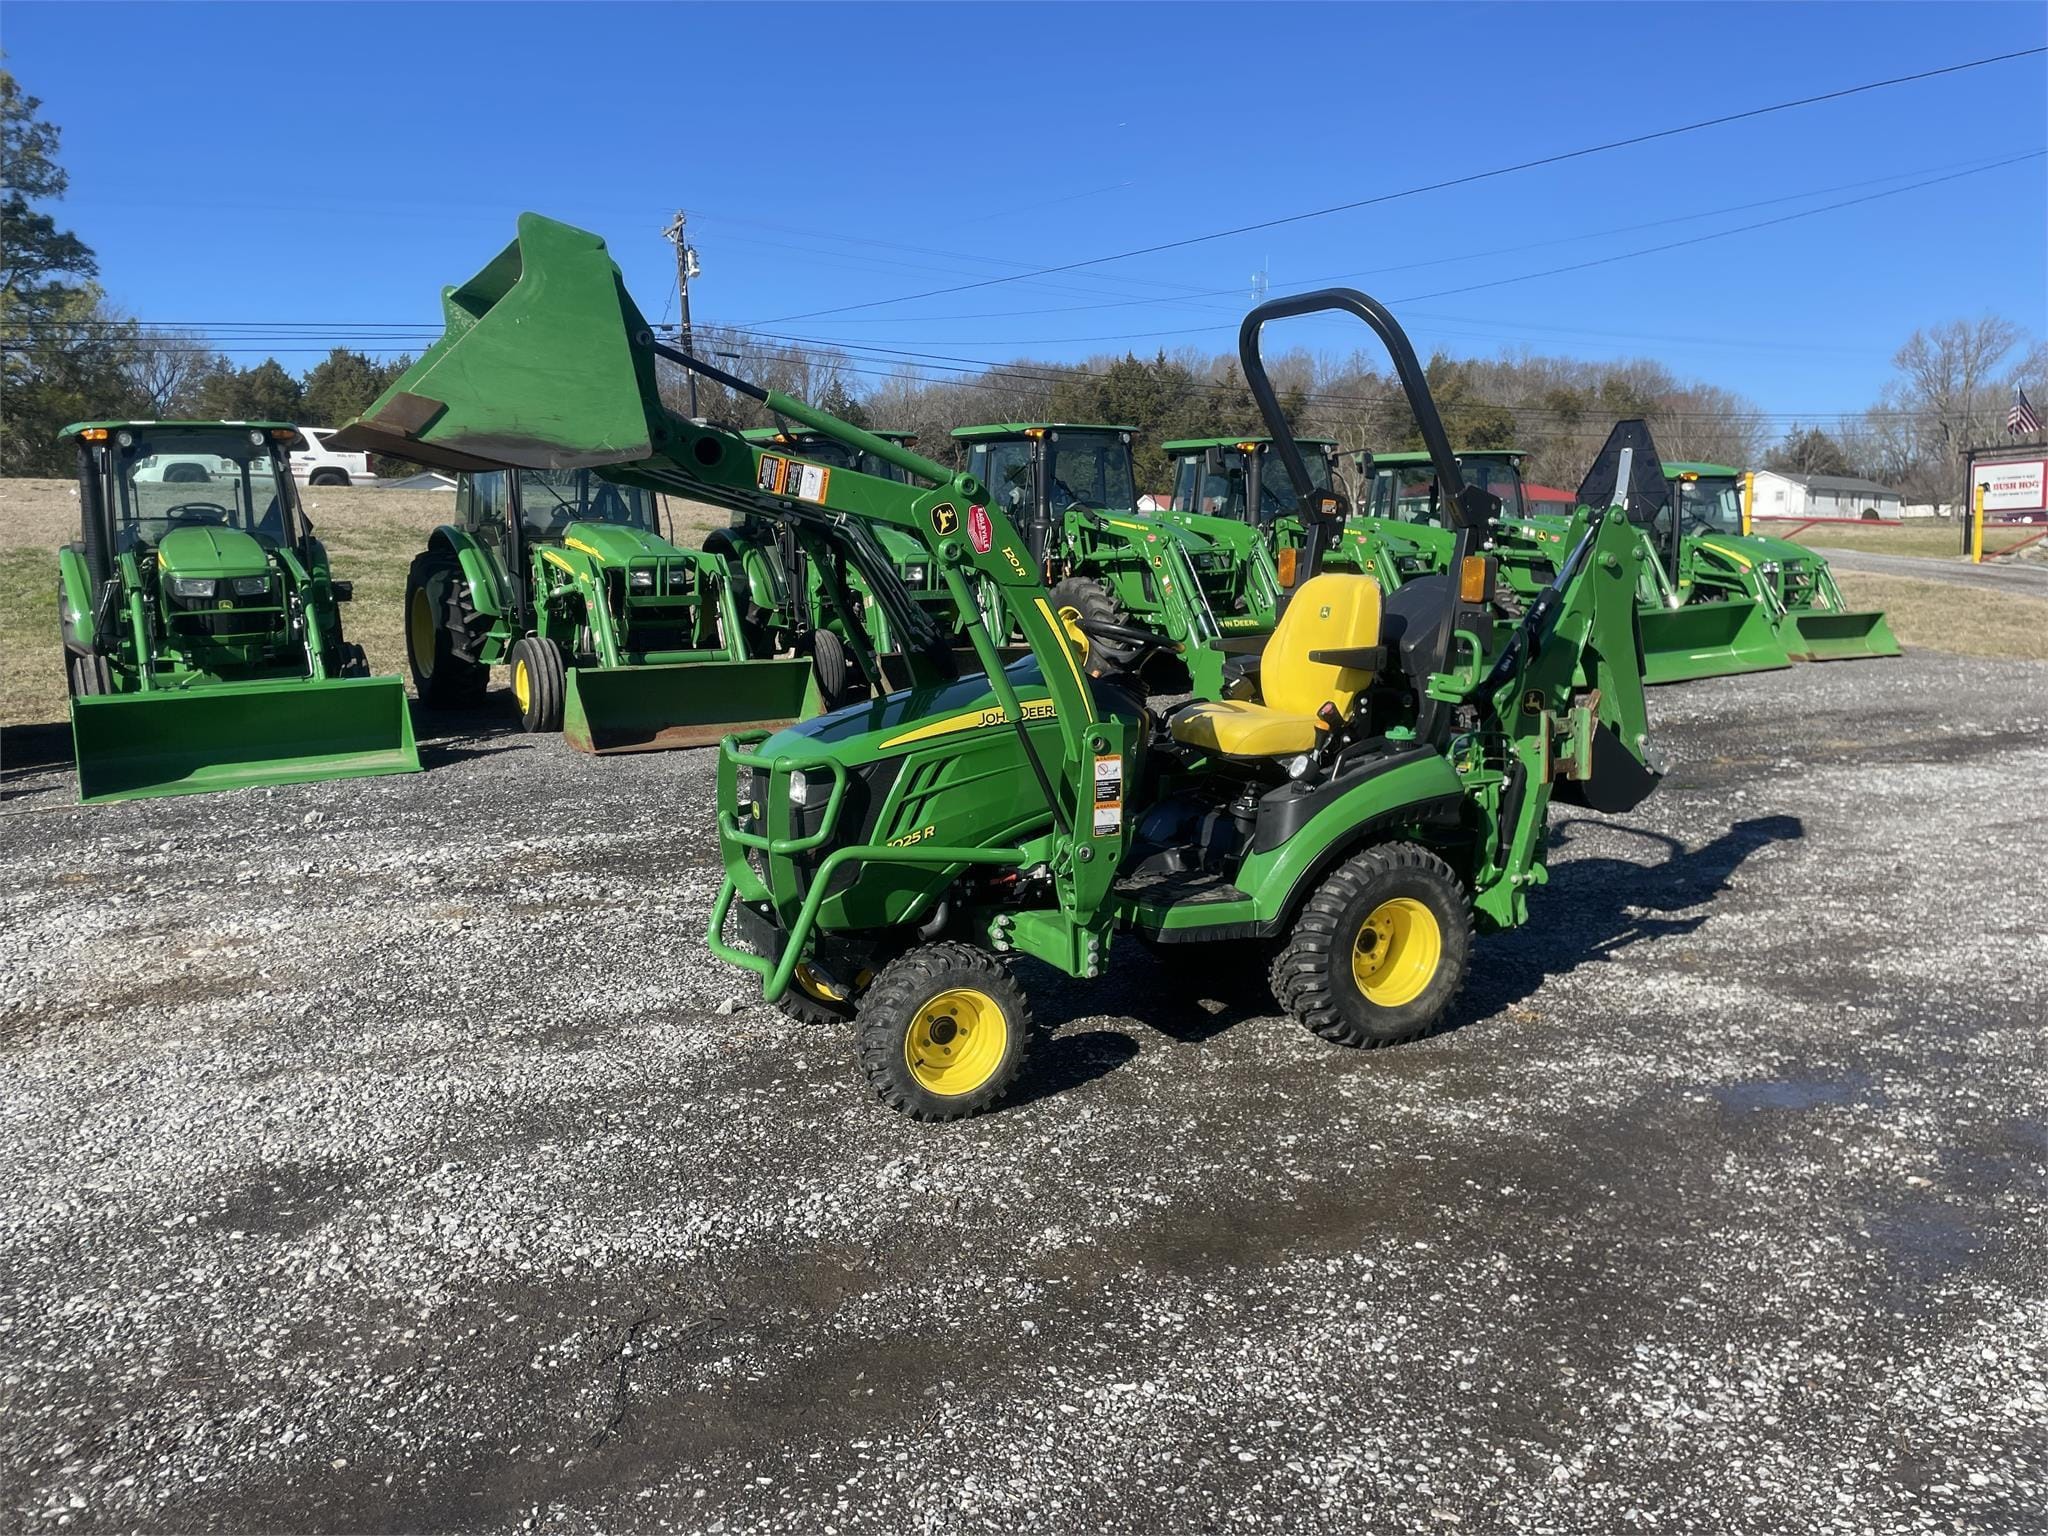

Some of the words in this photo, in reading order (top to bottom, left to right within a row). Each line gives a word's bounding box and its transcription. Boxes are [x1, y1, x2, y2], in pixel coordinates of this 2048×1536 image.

[1993, 482, 2017, 491] BUSH
[2019, 480, 2039, 489] HOG
[977, 507, 990, 549] EAGLEVILLE
[1233, 619, 1260, 627] DEERE
[978, 711, 1007, 726] JOH
